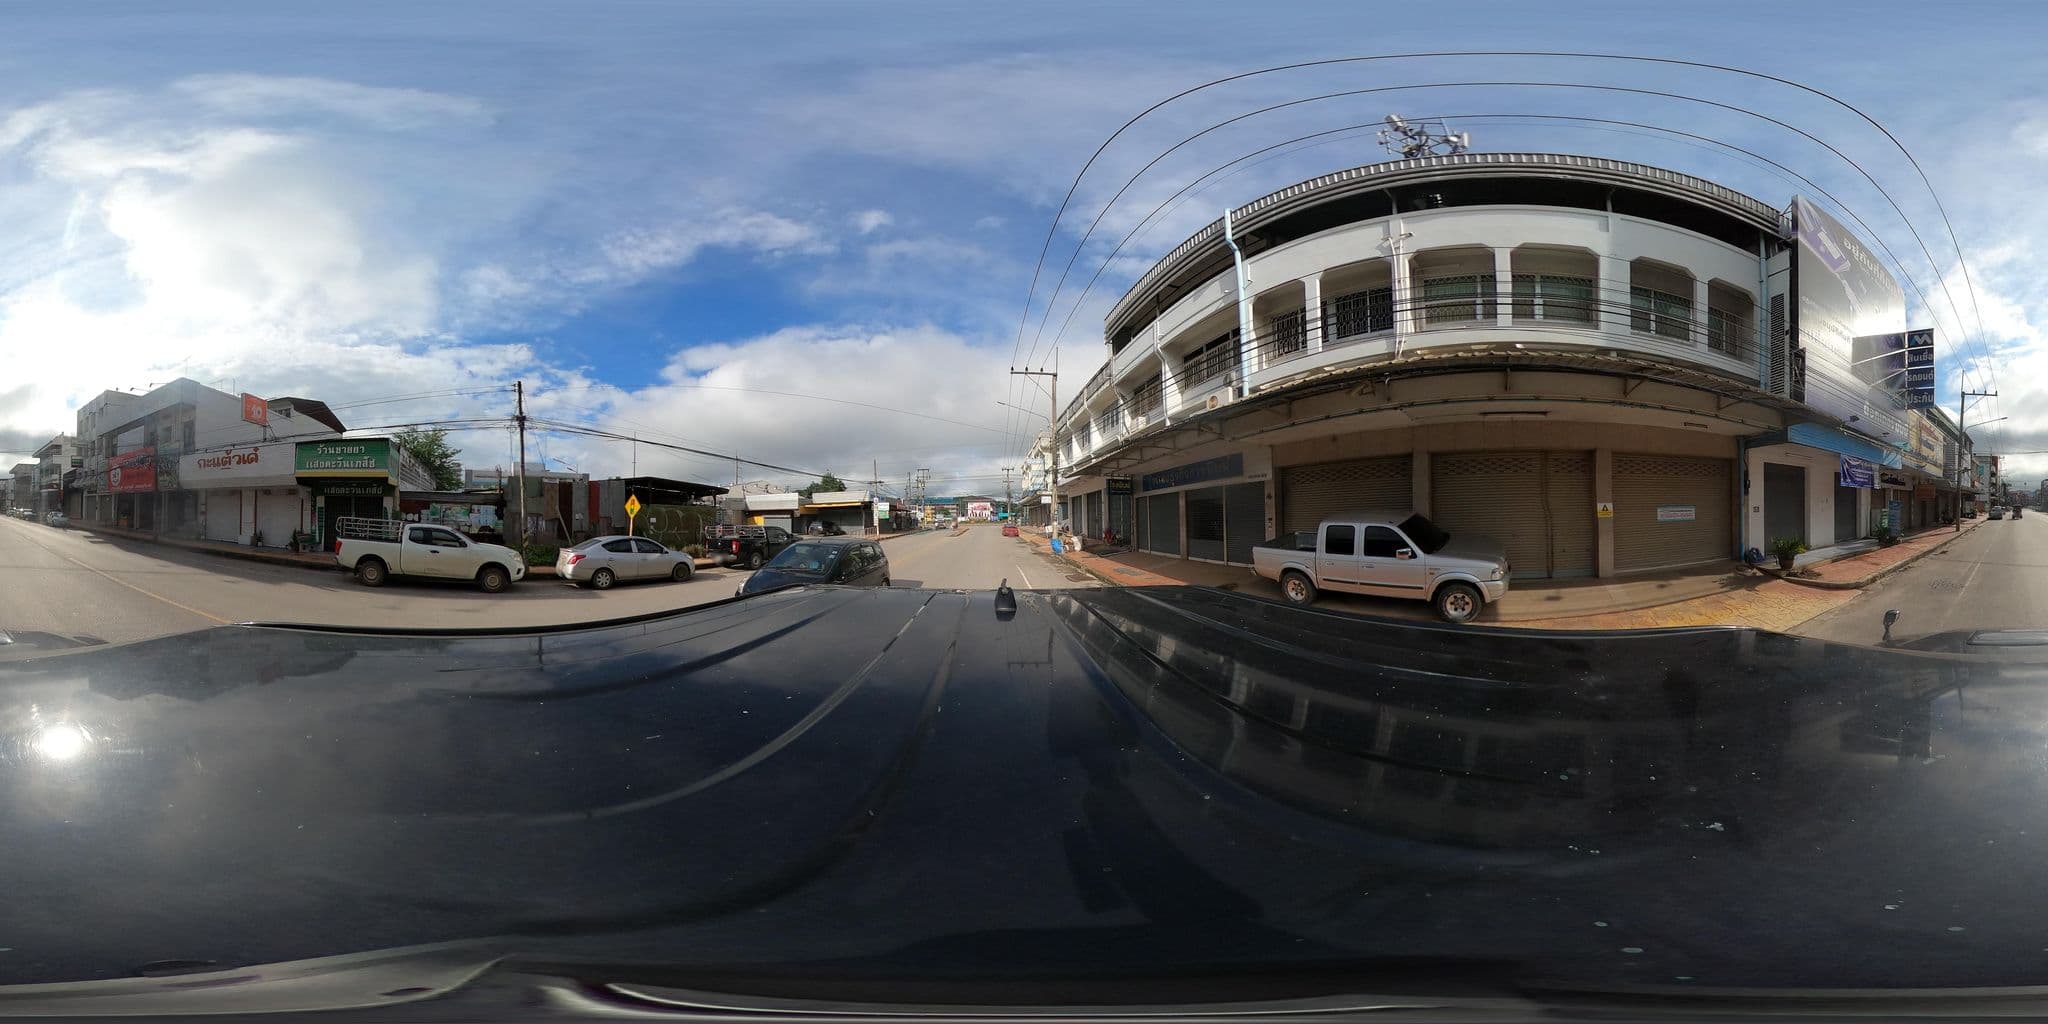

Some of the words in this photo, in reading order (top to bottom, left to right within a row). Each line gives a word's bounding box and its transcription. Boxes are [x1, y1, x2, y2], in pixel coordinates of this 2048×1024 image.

[1909, 349, 1934, 362] สินเชื่อ
[317, 443, 365, 454] ร้านขายยา
